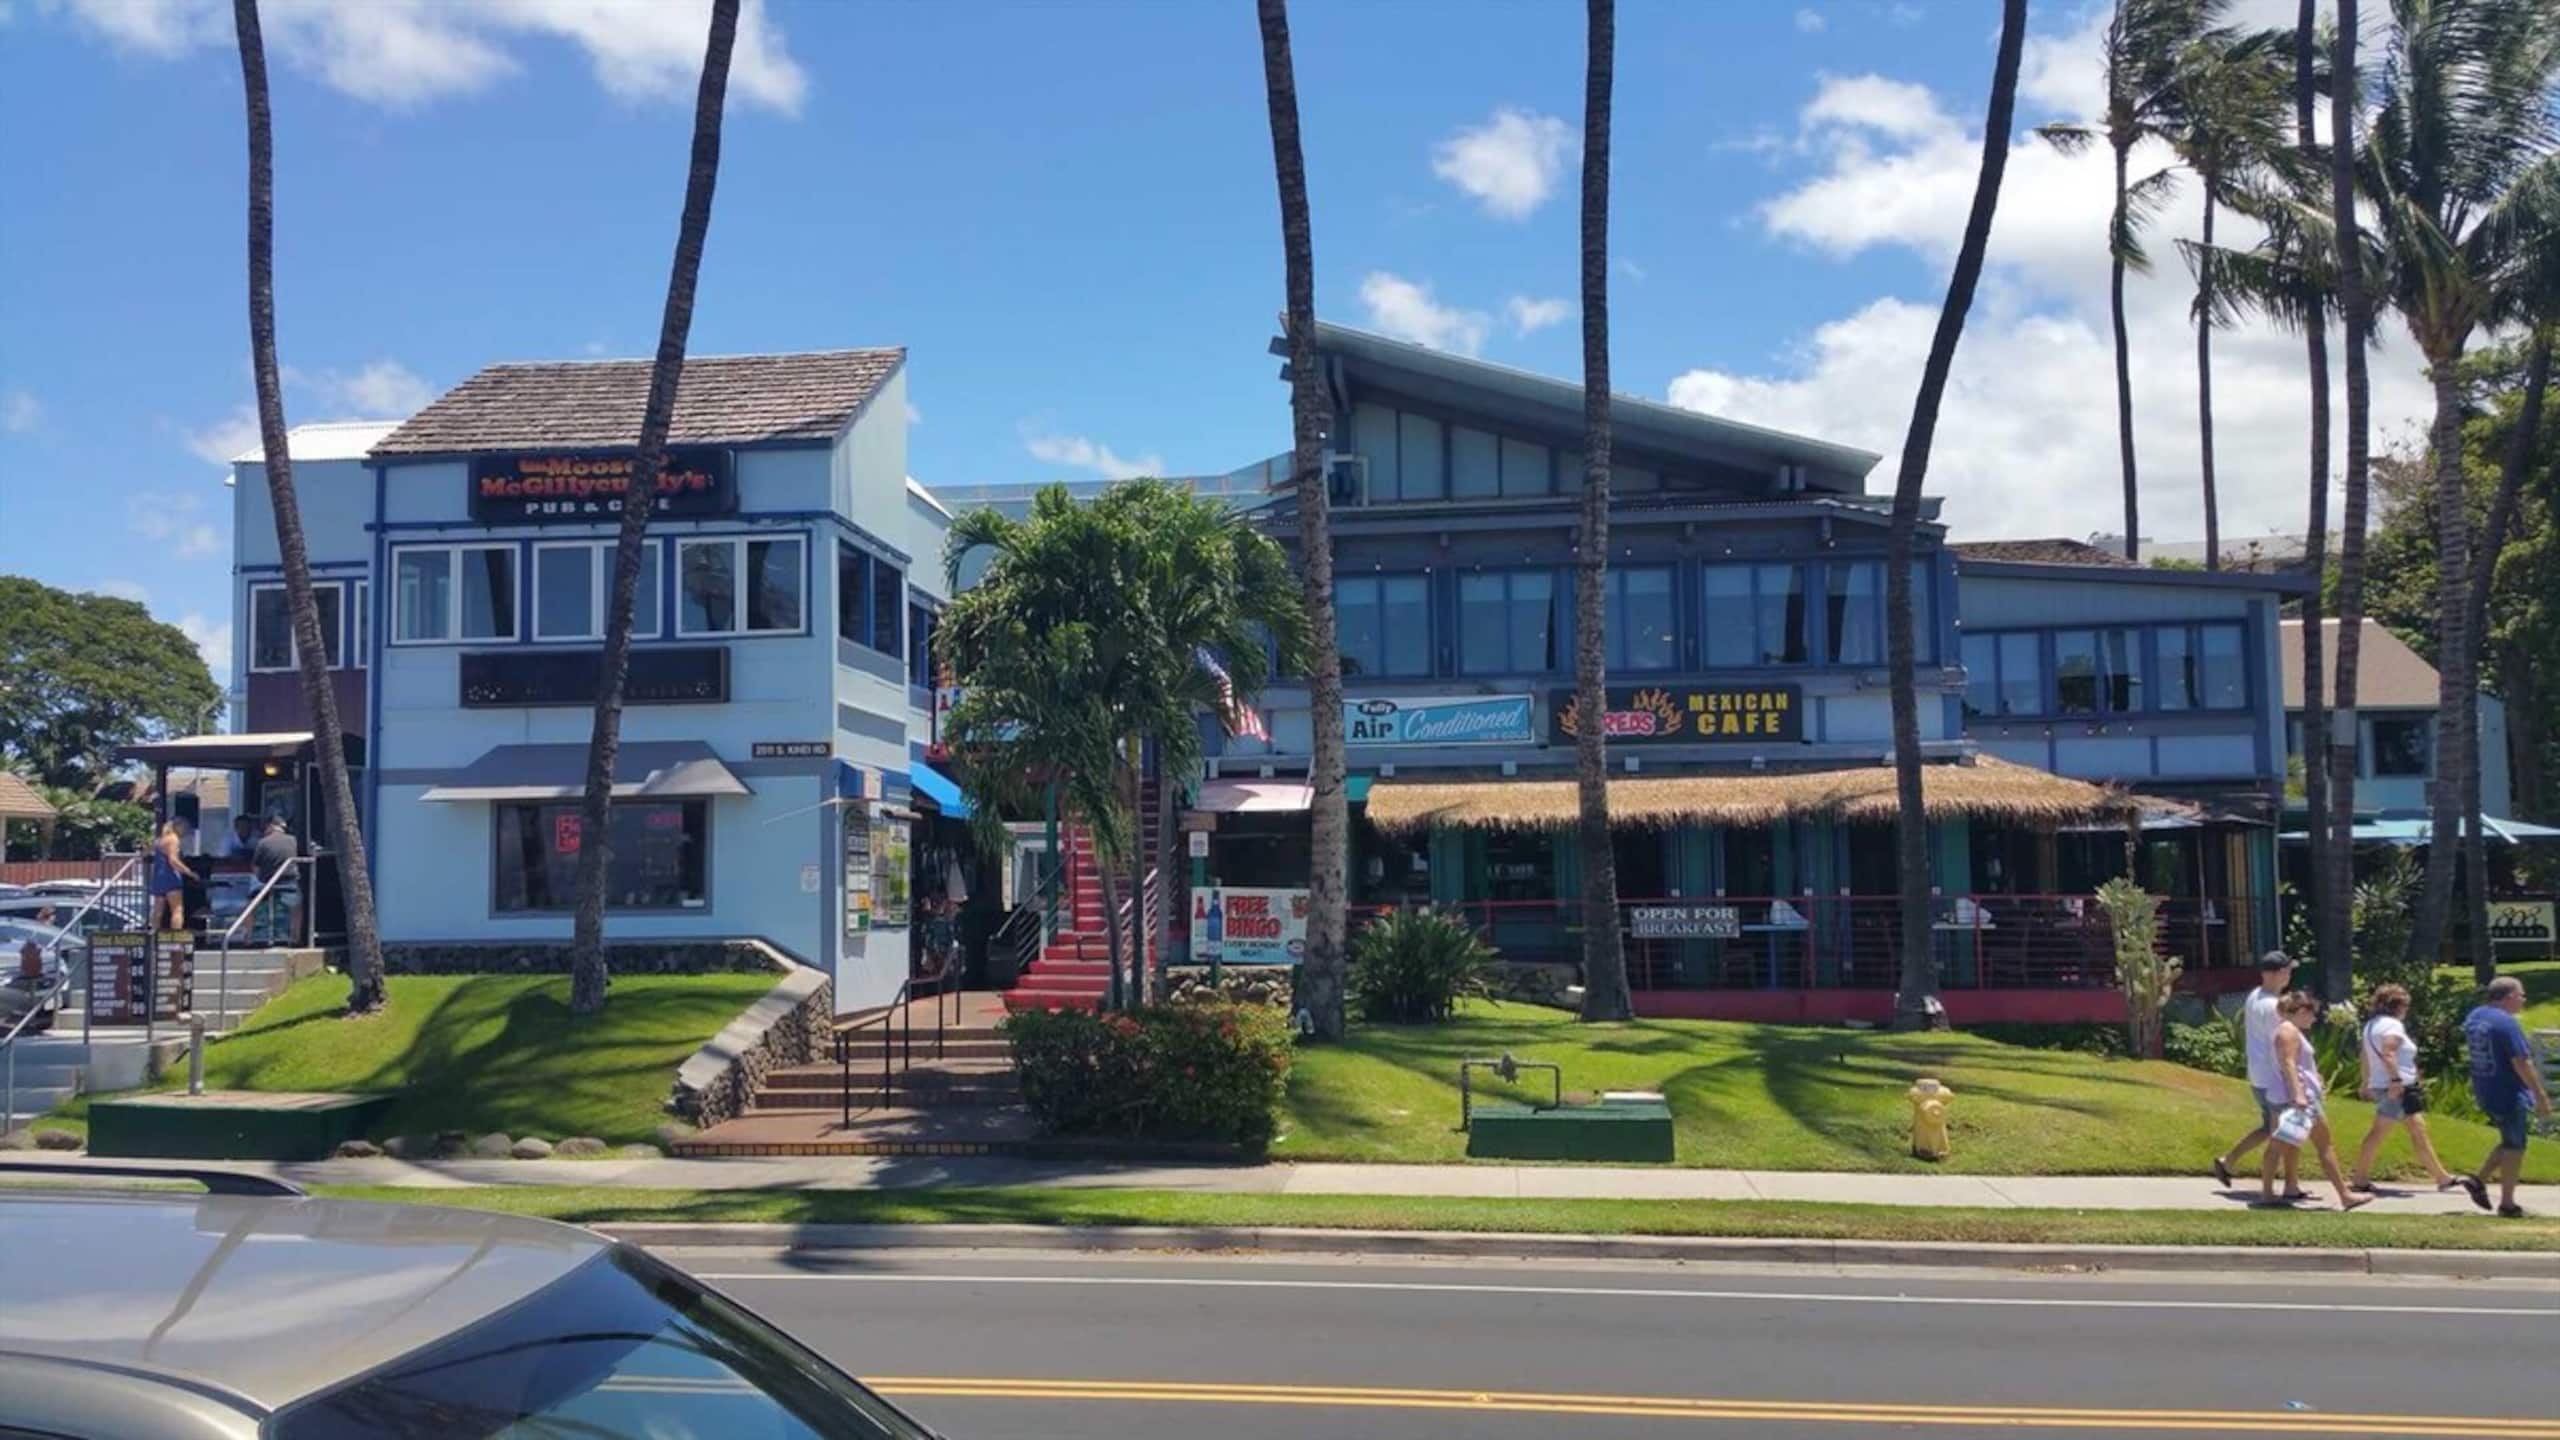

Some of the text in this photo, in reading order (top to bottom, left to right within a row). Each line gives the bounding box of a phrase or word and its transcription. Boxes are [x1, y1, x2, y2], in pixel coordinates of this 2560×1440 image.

[480, 473, 706, 497] McGillycuy's
[525, 499, 671, 515] PUB & CE
[1361, 701, 1394, 714] Fully
[1688, 694, 1788, 712] MEXICAN
[1352, 703, 1525, 740] Air Conditioned
[1697, 714, 1781, 734] CAFE
[1226, 896, 1269, 915] FREE
[1633, 907, 1734, 919] OPEN FOR
[1226, 917, 1281, 937] BINGO
[1636, 922, 1734, 934] BREAKFAST
